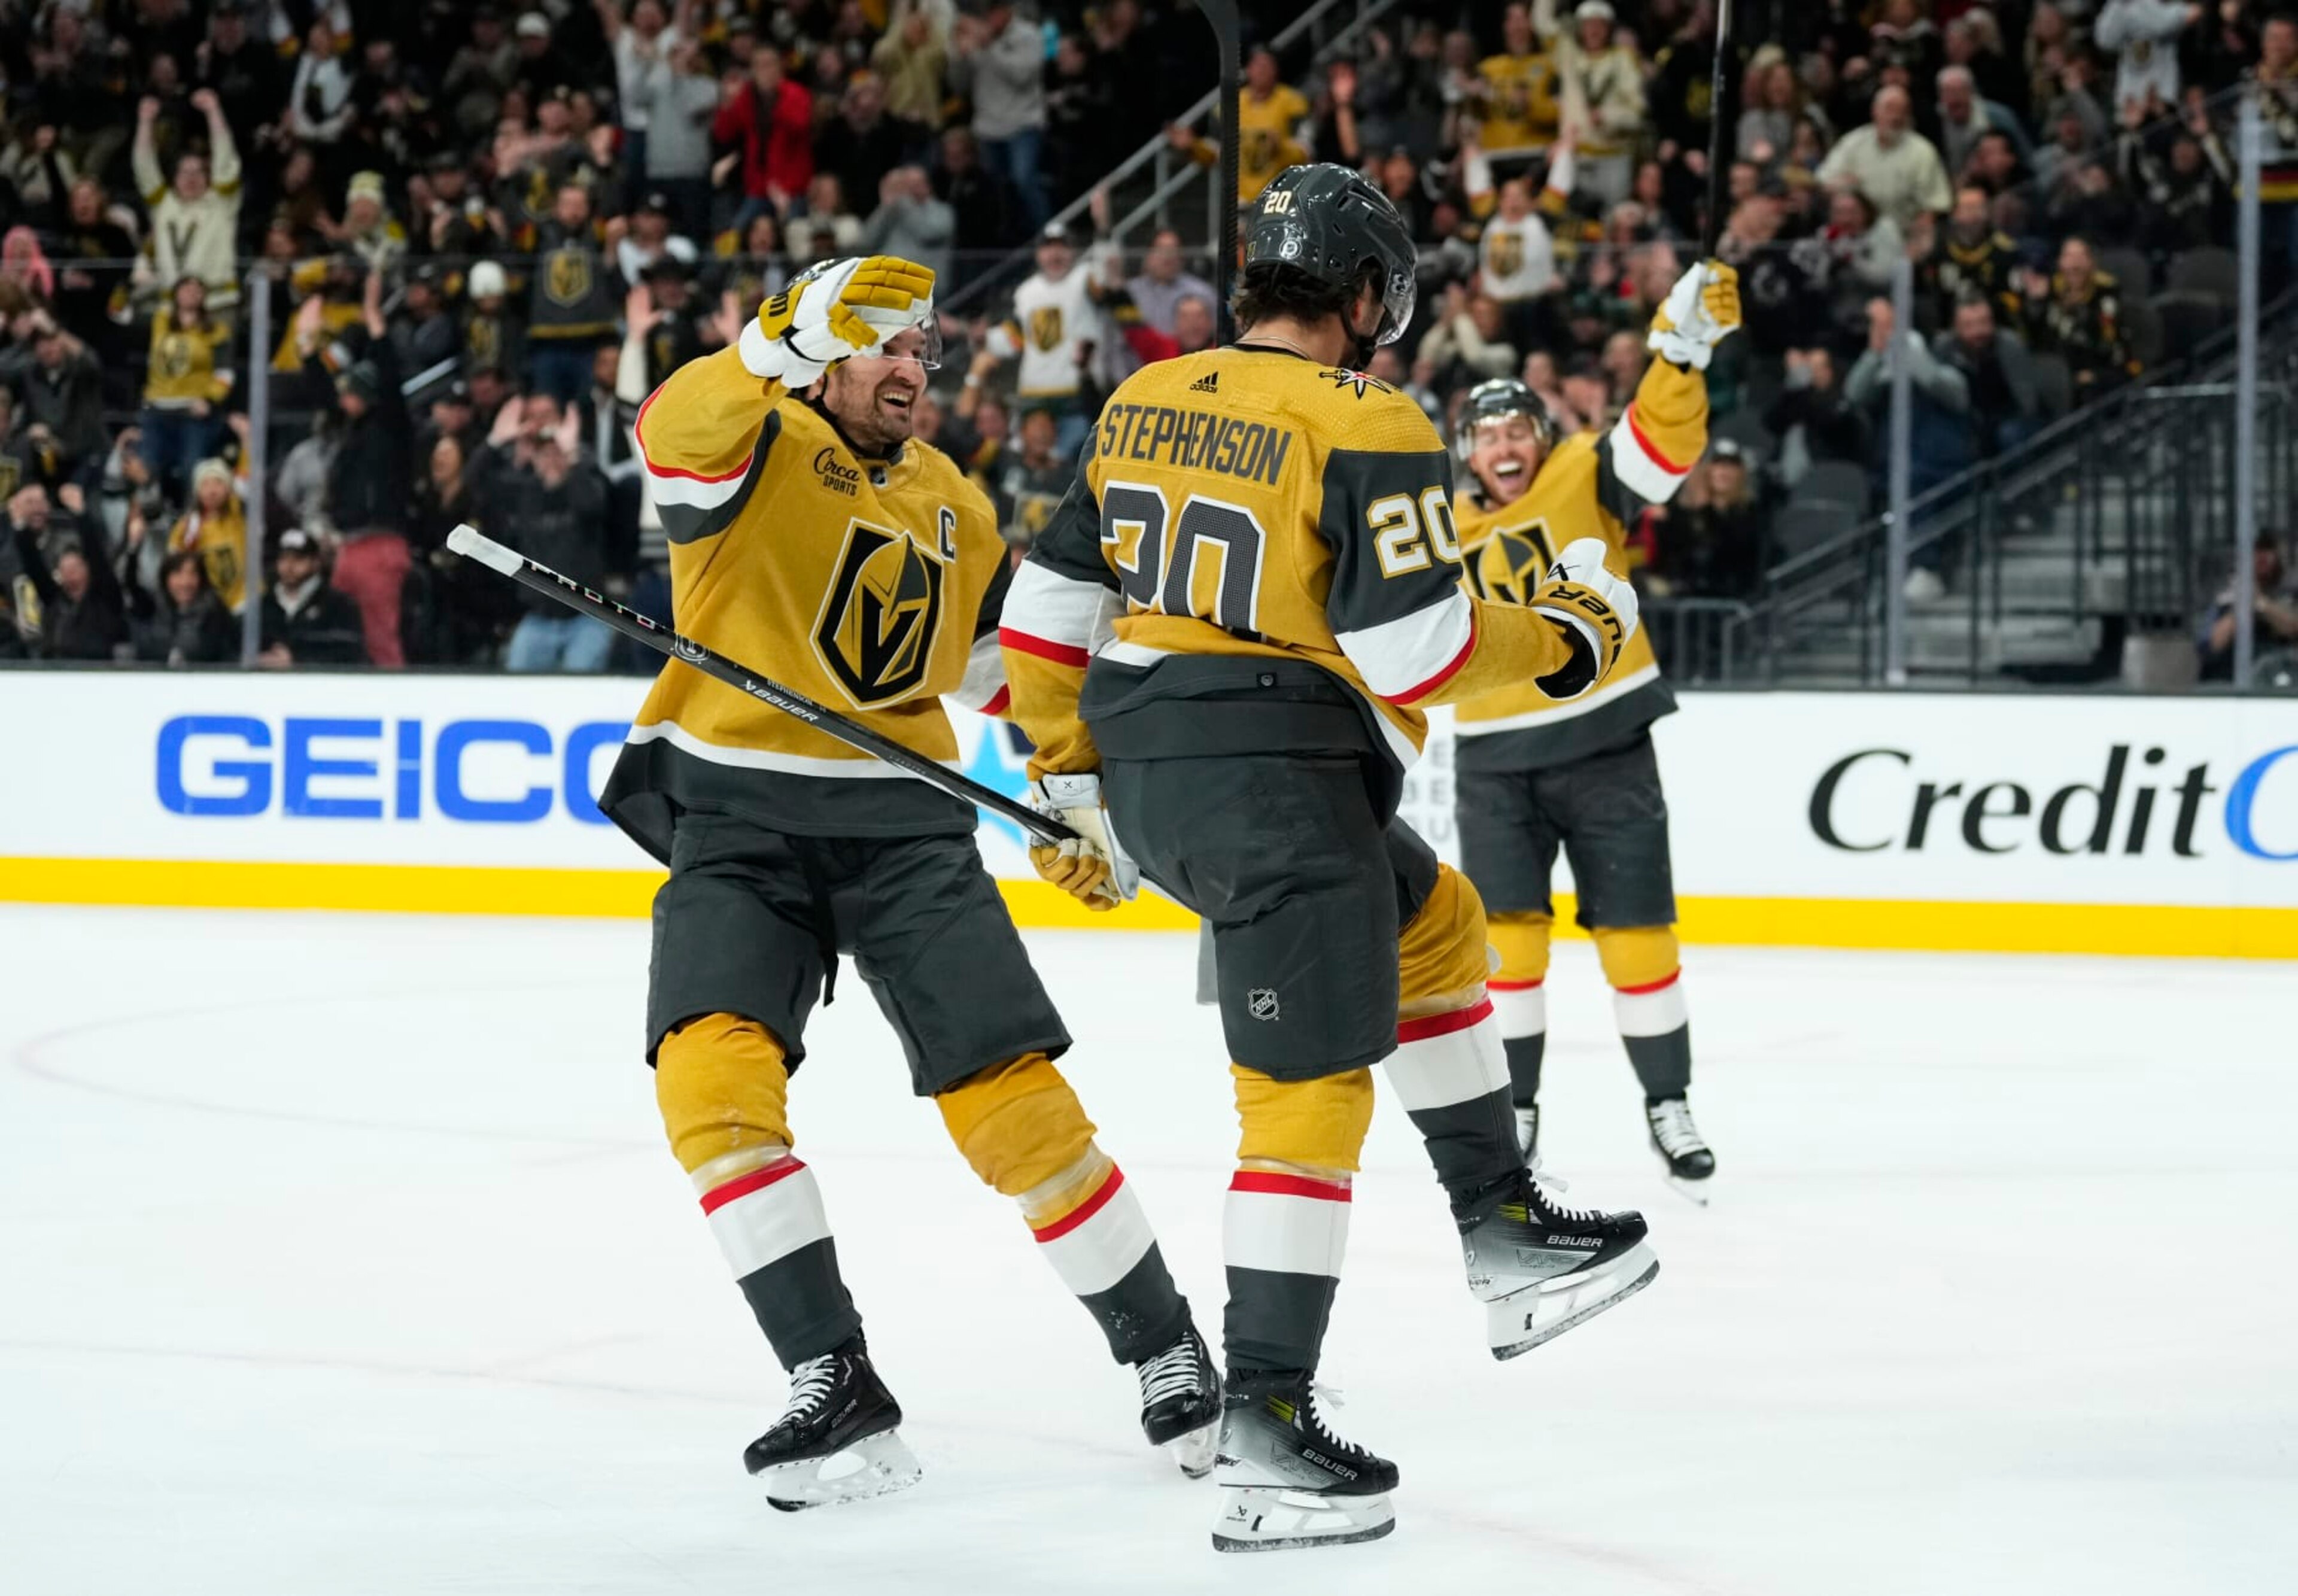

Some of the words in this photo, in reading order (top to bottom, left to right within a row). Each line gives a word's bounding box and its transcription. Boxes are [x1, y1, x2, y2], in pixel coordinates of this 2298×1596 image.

[1264, 191, 1292, 214] 20
[1189, 384, 1218, 394] adidas
[1101, 403, 1291, 487] STEPHENSON
[814, 448, 859, 482] Circa
[823, 475, 857, 497] SPORTS
[938, 504, 956, 563] C
[1366, 485, 1462, 580] 20
[1101, 480, 1266, 633] 20
[752, 688, 819, 722] BAUER
[1547, 1235, 1603, 1248] BAUER
[1302, 1448, 1359, 1482] BAUER
